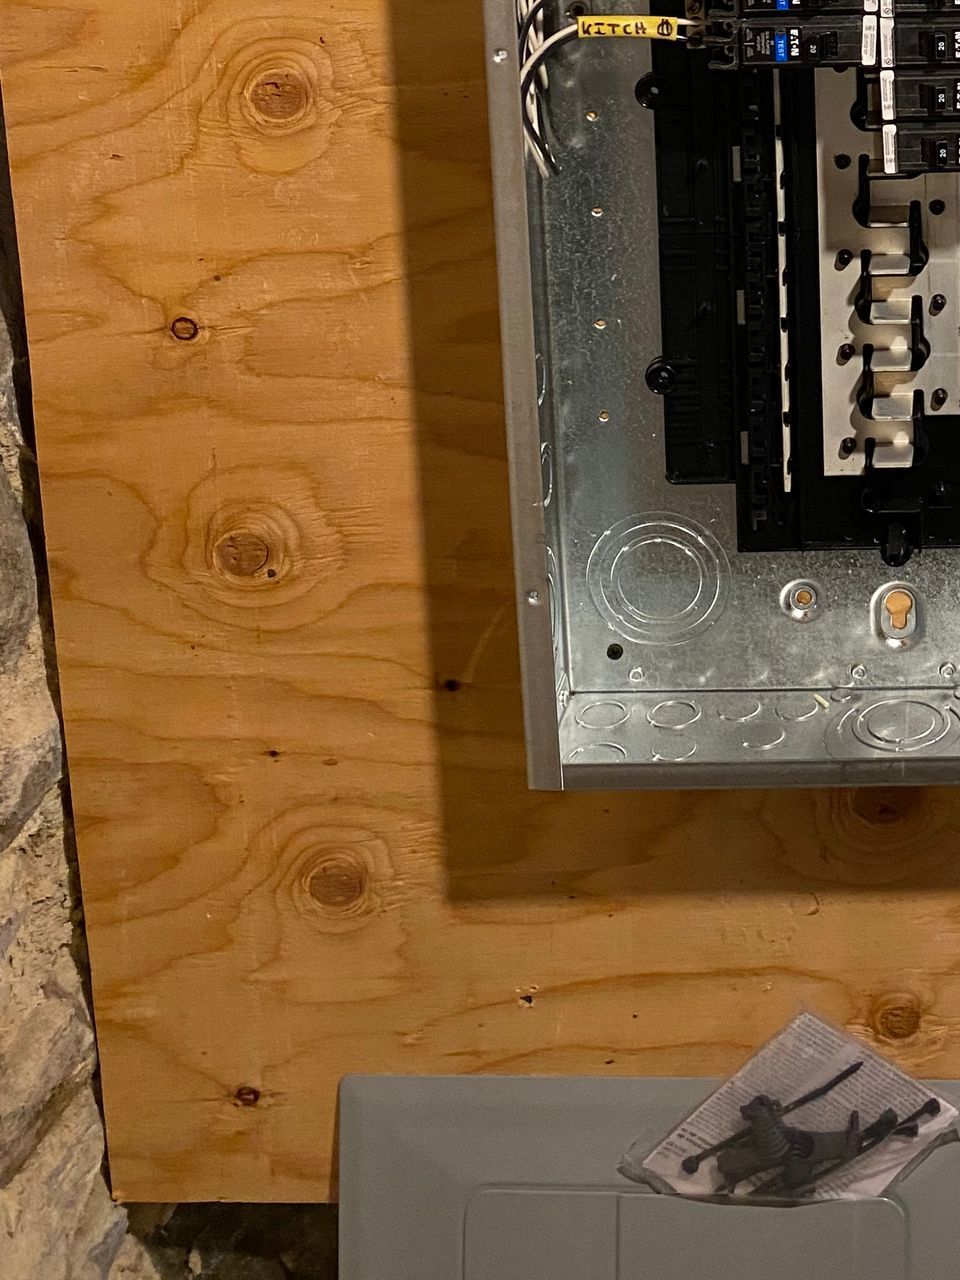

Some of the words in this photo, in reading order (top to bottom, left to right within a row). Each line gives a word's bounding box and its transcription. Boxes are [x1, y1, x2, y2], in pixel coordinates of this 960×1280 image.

[581, 21, 647, 36] KITCH
[809, 44, 816, 53] 20
[938, 41, 945, 51] 20
[938, 93, 945, 103] 20
[939, 148, 946, 158] 20
